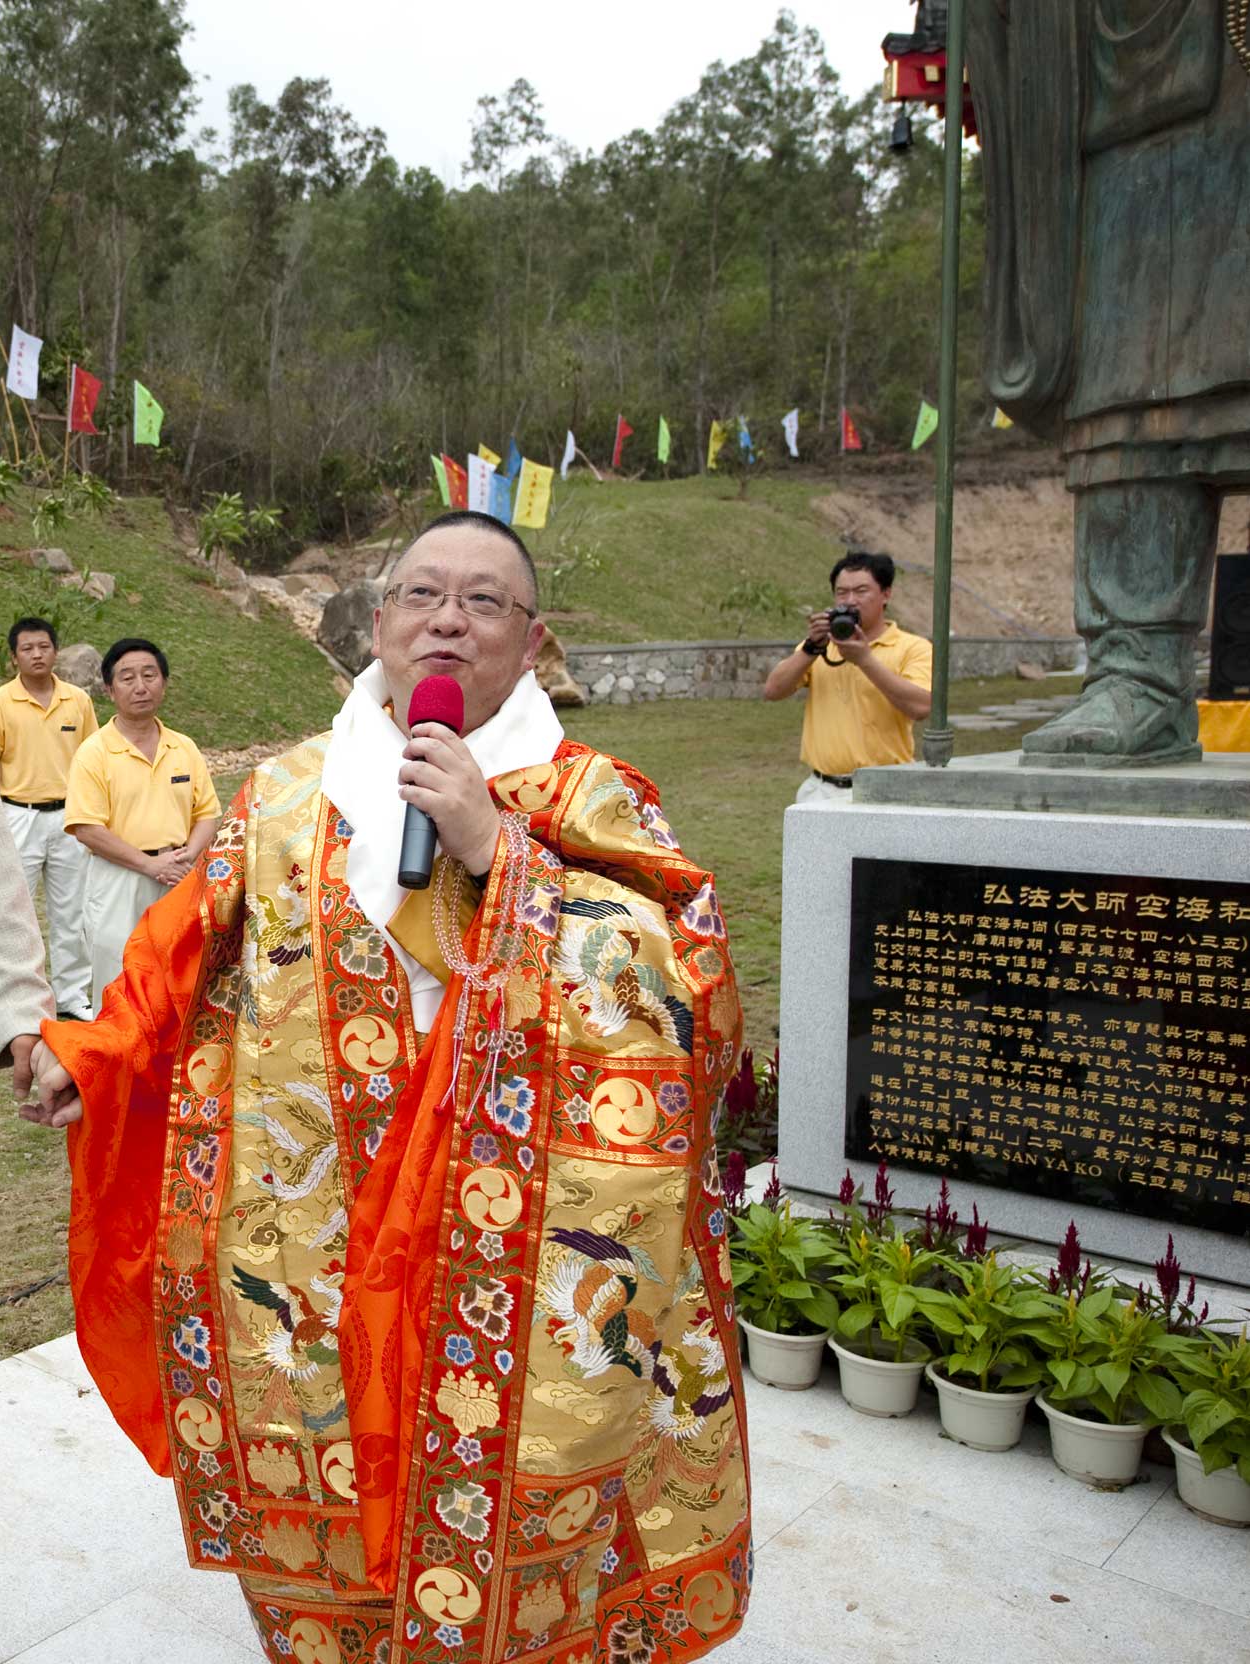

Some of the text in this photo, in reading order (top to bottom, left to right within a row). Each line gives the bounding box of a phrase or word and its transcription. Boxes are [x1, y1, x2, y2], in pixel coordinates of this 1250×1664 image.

[983, 881, 1250, 926] 弘法大師空海和
[870, 1123, 892, 1140] YA
[901, 1129, 935, 1147] SAN
[1001, 1147, 1041, 1167] SAN
[1044, 1155, 1069, 1172] YA
[1075, 1160, 1102, 1178] KO
